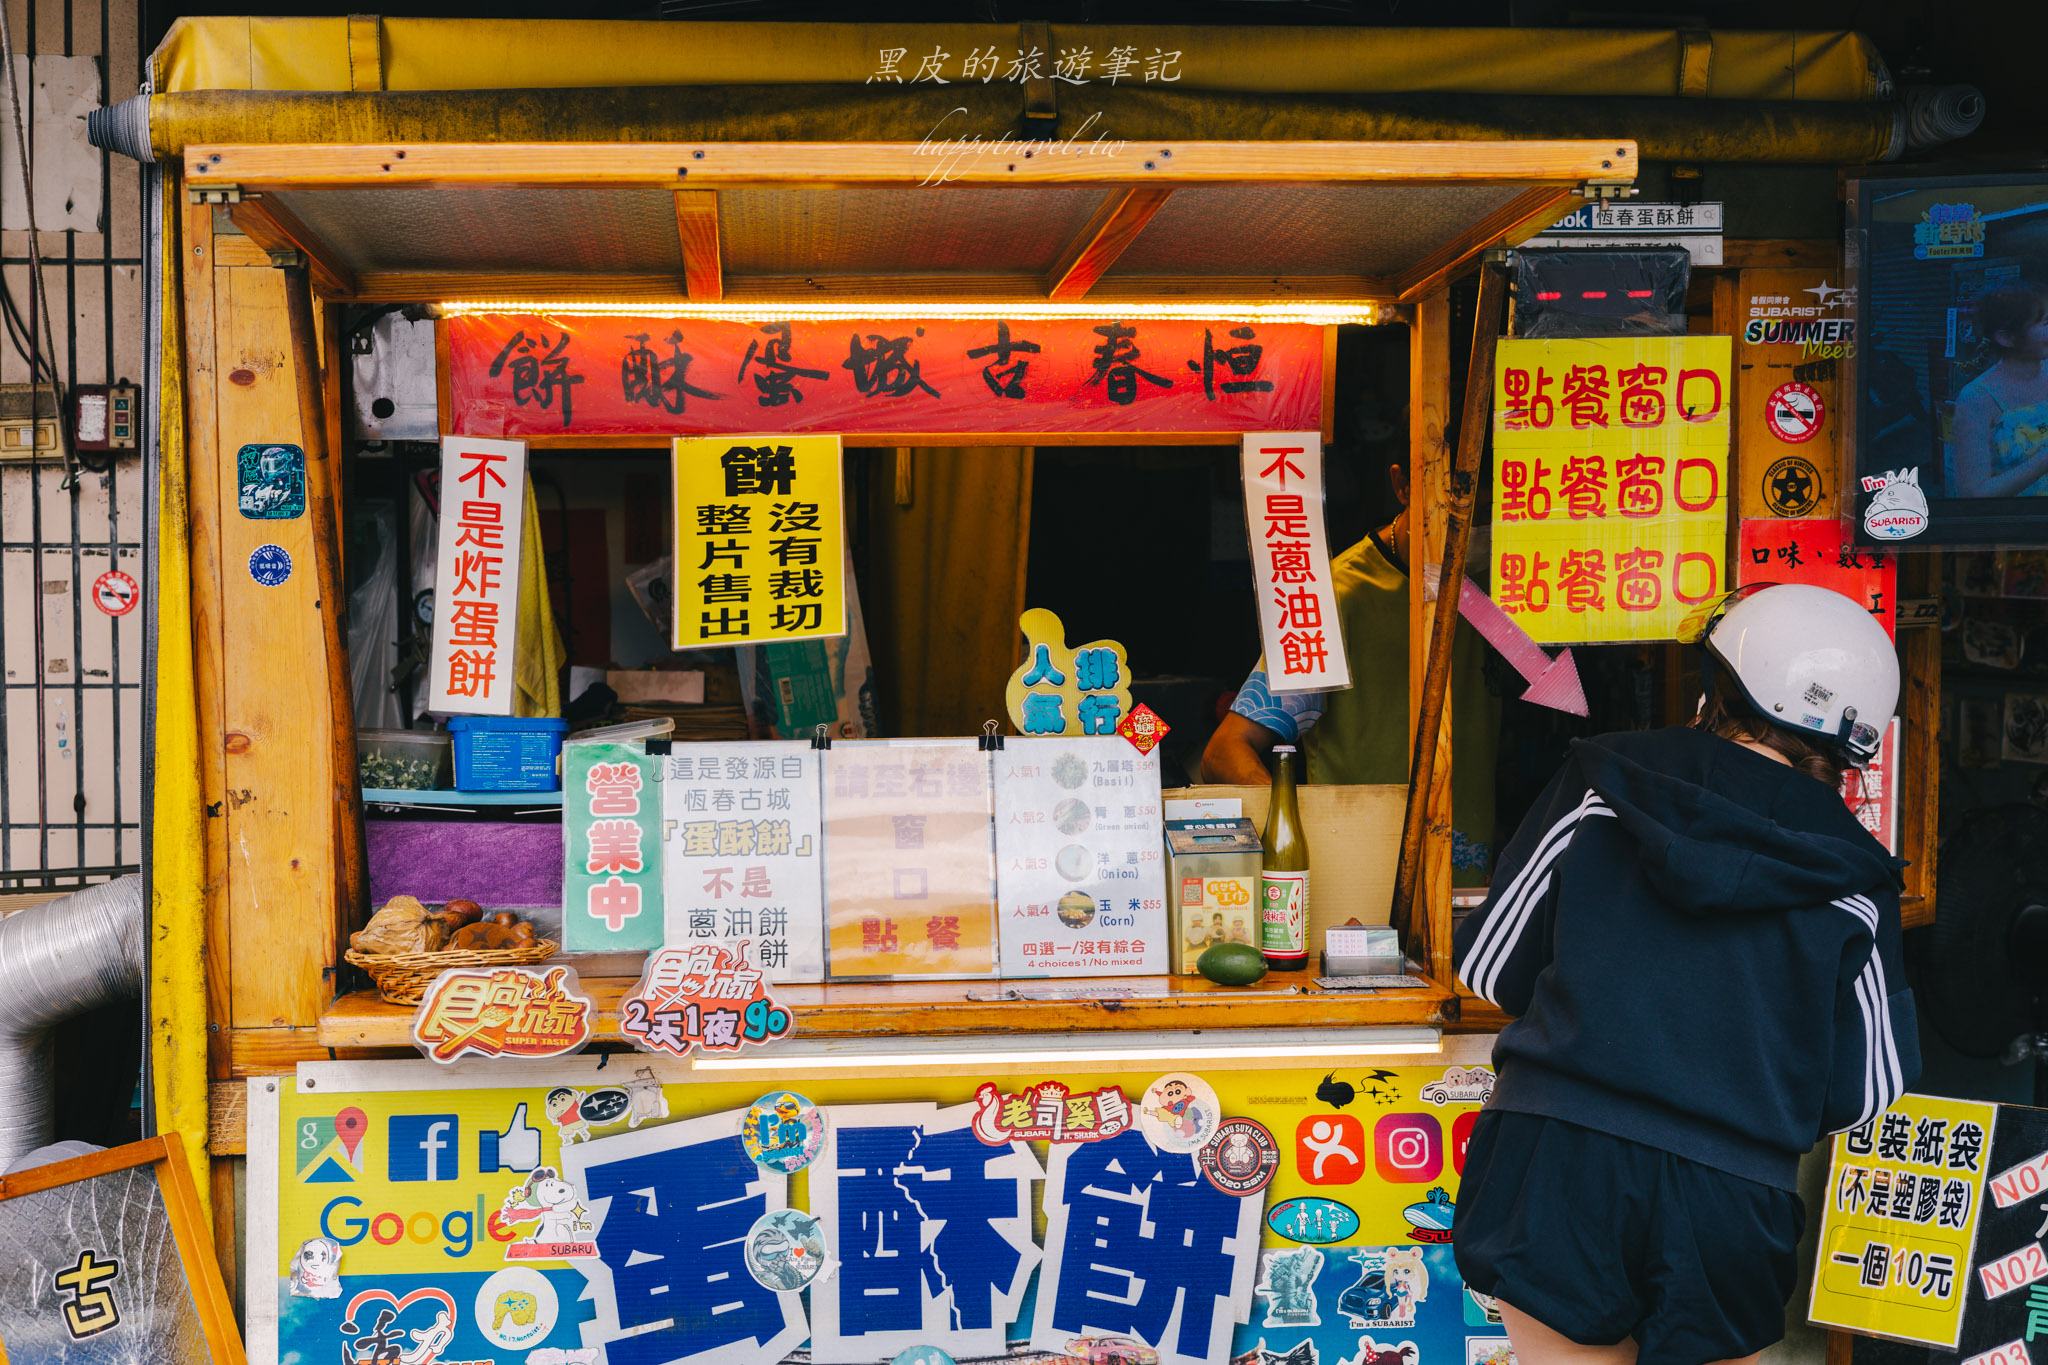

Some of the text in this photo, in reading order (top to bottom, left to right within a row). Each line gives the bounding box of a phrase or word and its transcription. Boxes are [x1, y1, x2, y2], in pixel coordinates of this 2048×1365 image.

[1749, 307, 1825, 317] SUBARIST
[1746, 320, 1856, 344] SUMMER
[1802, 337, 1857, 360] Meet
[1503, 362, 1722, 431] 點餐窗口
[720, 445, 797, 497] 餅
[1499, 453, 1720, 524] 點餐窗口
[1870, 516, 1921, 528] SUBARIST
[696, 504, 753, 639] 整片售出
[768, 500, 825, 633] 沒有裁切
[1259, 447, 1329, 676] 不是蔥油餅
[446, 452, 508, 699] 不是炸蛋餅
[1498, 546, 1717, 615] 點餐窗口
[670, 756, 802, 781] 這是發源自
[684, 787, 791, 812] 恆春古城
[1138, 805, 1157, 816] $50
[1010, 811, 1046, 824] 人氣2
[586, 761, 643, 932] 營業中
[1140, 852, 1159, 862] $50
[1012, 858, 1048, 871] 人氣3
[1097, 869, 1139, 880] (Onion)
[702, 866, 773, 900] 不是
[1013, 904, 1050, 918] 人氣4
[1100, 899, 1162, 912] 玉米 $55
[1100, 915, 1135, 928] (Corn)
[862, 916, 961, 952] 點餐
[1022, 939, 1147, 957] 四選一/沒有綜合
[1028, 960, 1035, 968] 4
[1111, 957, 1144, 967] mixed
[505, 1037, 570, 1046] SUPER TASTE
[1210, 1123, 1269, 1148] SUBARU SUYA CLUB
[1847, 1113, 1983, 1171] 包裝紙袋
[1213, 1170, 1267, 1189] 2020 SBM
[320, 1195, 517, 1258] Google
[551, 1244, 593, 1256] SUBARU
[1833, 1241, 1953, 1297] 一個10元
[1372, 1320, 1415, 1328] SUBARIST
